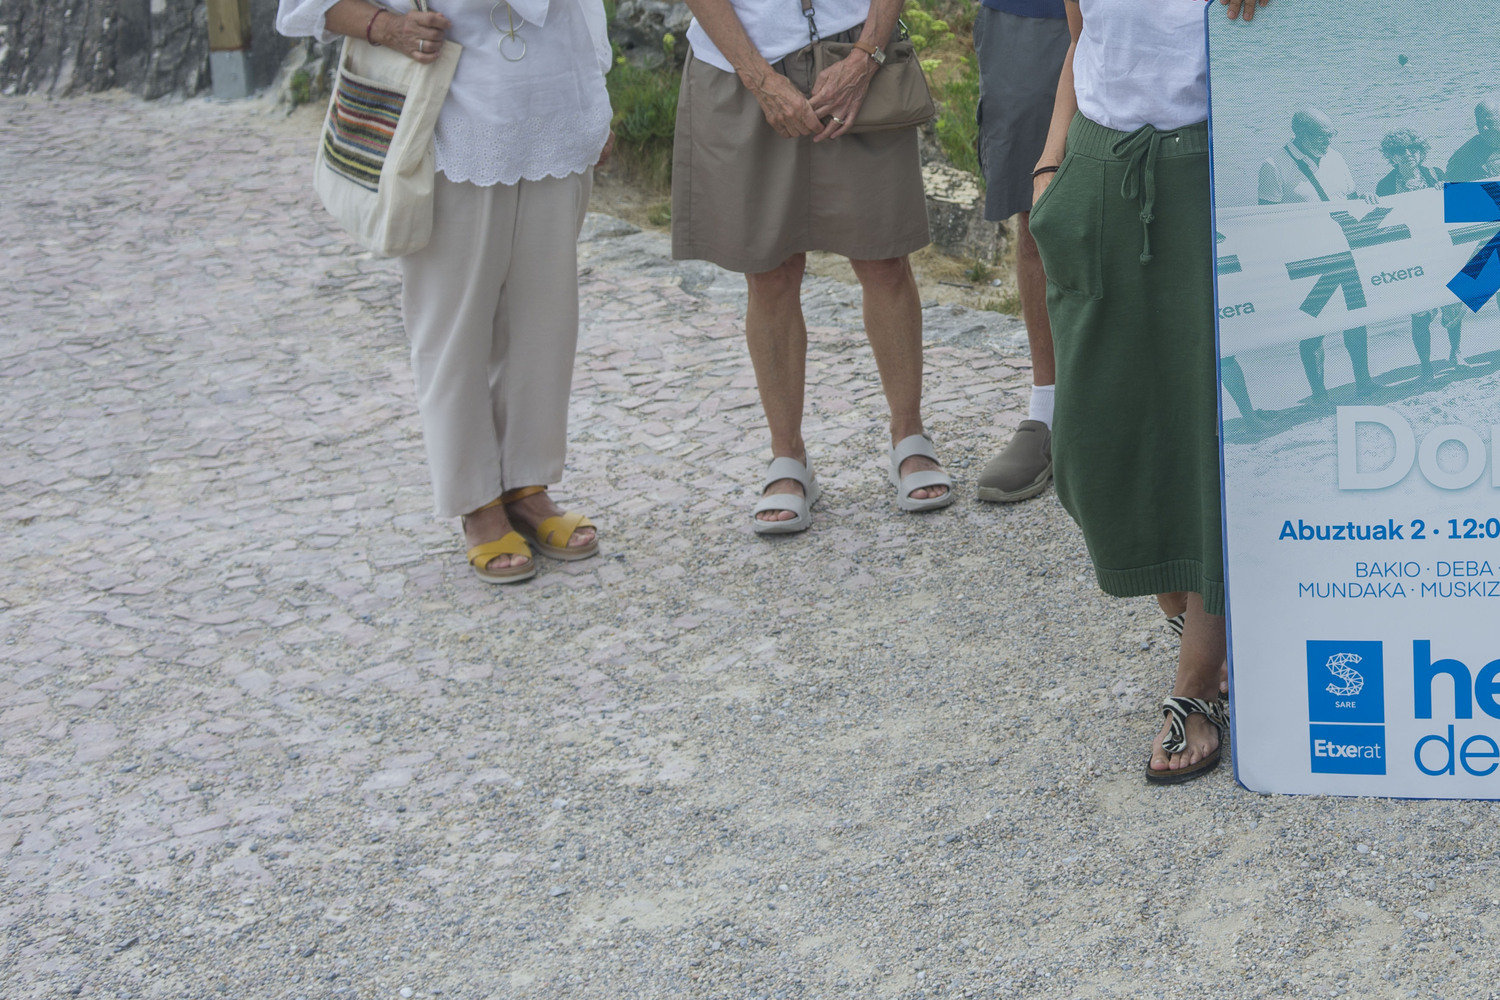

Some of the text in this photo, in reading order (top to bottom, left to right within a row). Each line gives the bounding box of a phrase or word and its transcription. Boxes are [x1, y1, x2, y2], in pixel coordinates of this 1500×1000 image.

[1370, 265, 1424, 286] etxera
[1279, 519, 1404, 540] Abuztuak
[1411, 519, 1426, 540] 2
[1356, 561, 1421, 578] BAKIO
[1437, 560, 1494, 577] DEBA
[1299, 582, 1406, 598] MUNDAKA
[1335, 701, 1357, 709] SARE
[1314, 739, 1381, 759] Etxerat
